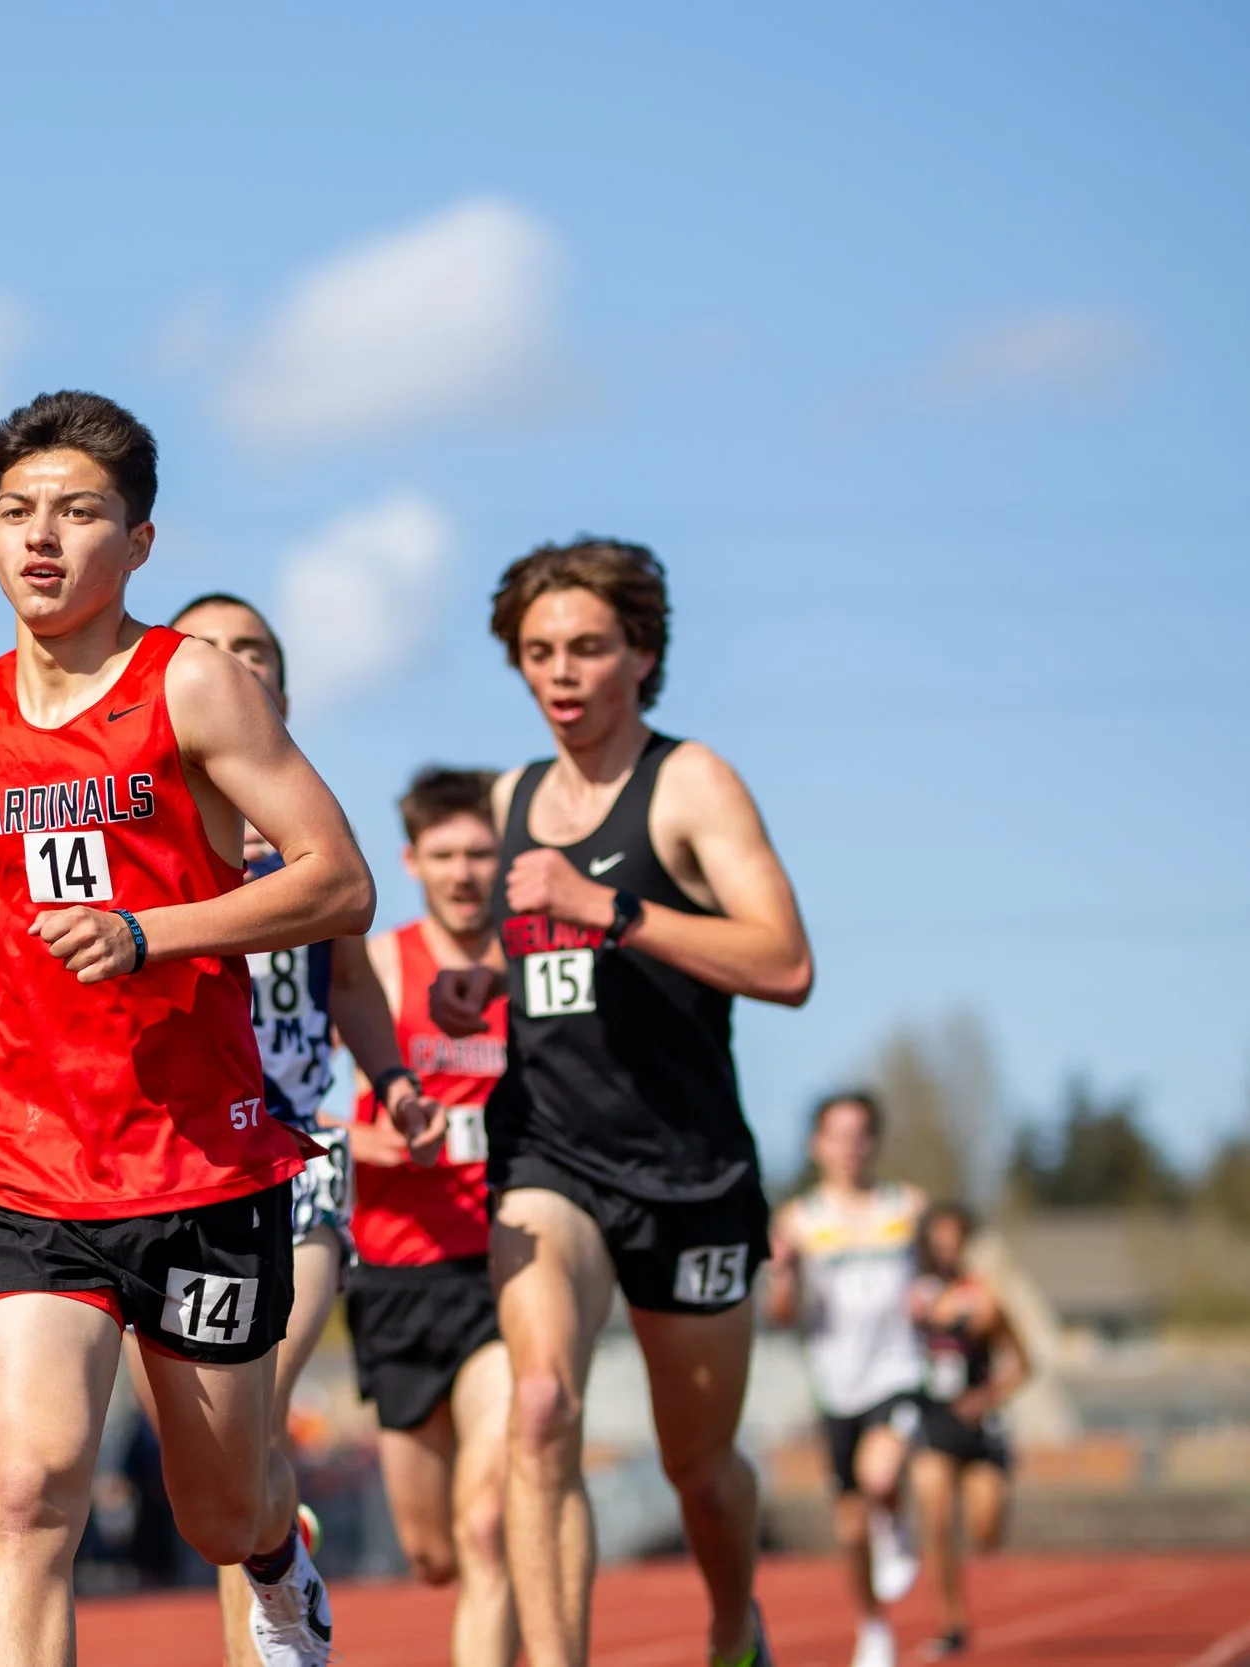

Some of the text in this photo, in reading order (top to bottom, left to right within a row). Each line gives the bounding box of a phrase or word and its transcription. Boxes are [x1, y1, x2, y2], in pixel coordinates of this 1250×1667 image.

[39, 837, 97, 899] 14
[538, 957, 579, 1008] 15
[230, 1098, 262, 1131] 57
[695, 1251, 735, 1297] 15
[182, 1277, 242, 1341] 14
